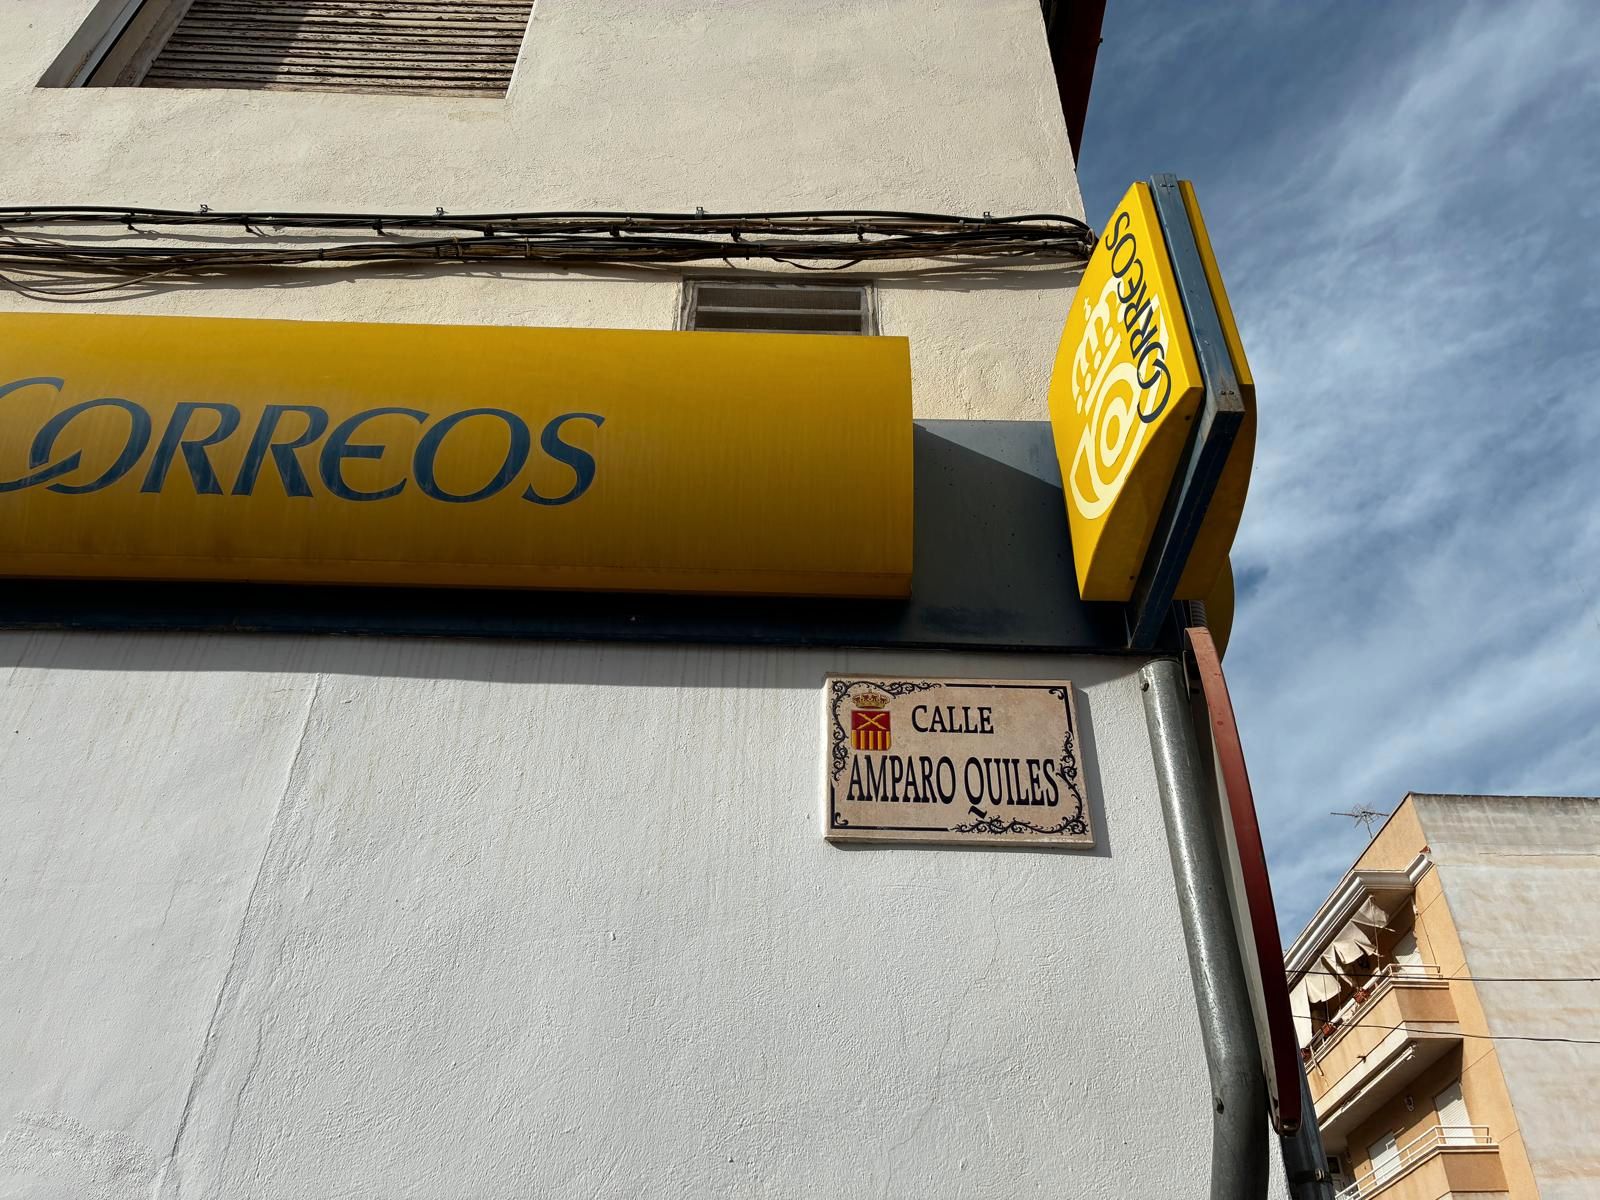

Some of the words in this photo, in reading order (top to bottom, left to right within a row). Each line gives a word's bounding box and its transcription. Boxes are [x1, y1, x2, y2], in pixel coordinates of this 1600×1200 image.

[1105, 211, 1172, 424] CORREOS
[911, 704, 994, 734] CALLE
[846, 754, 956, 804] AMPARO
[964, 756, 1059, 819] QUILES
